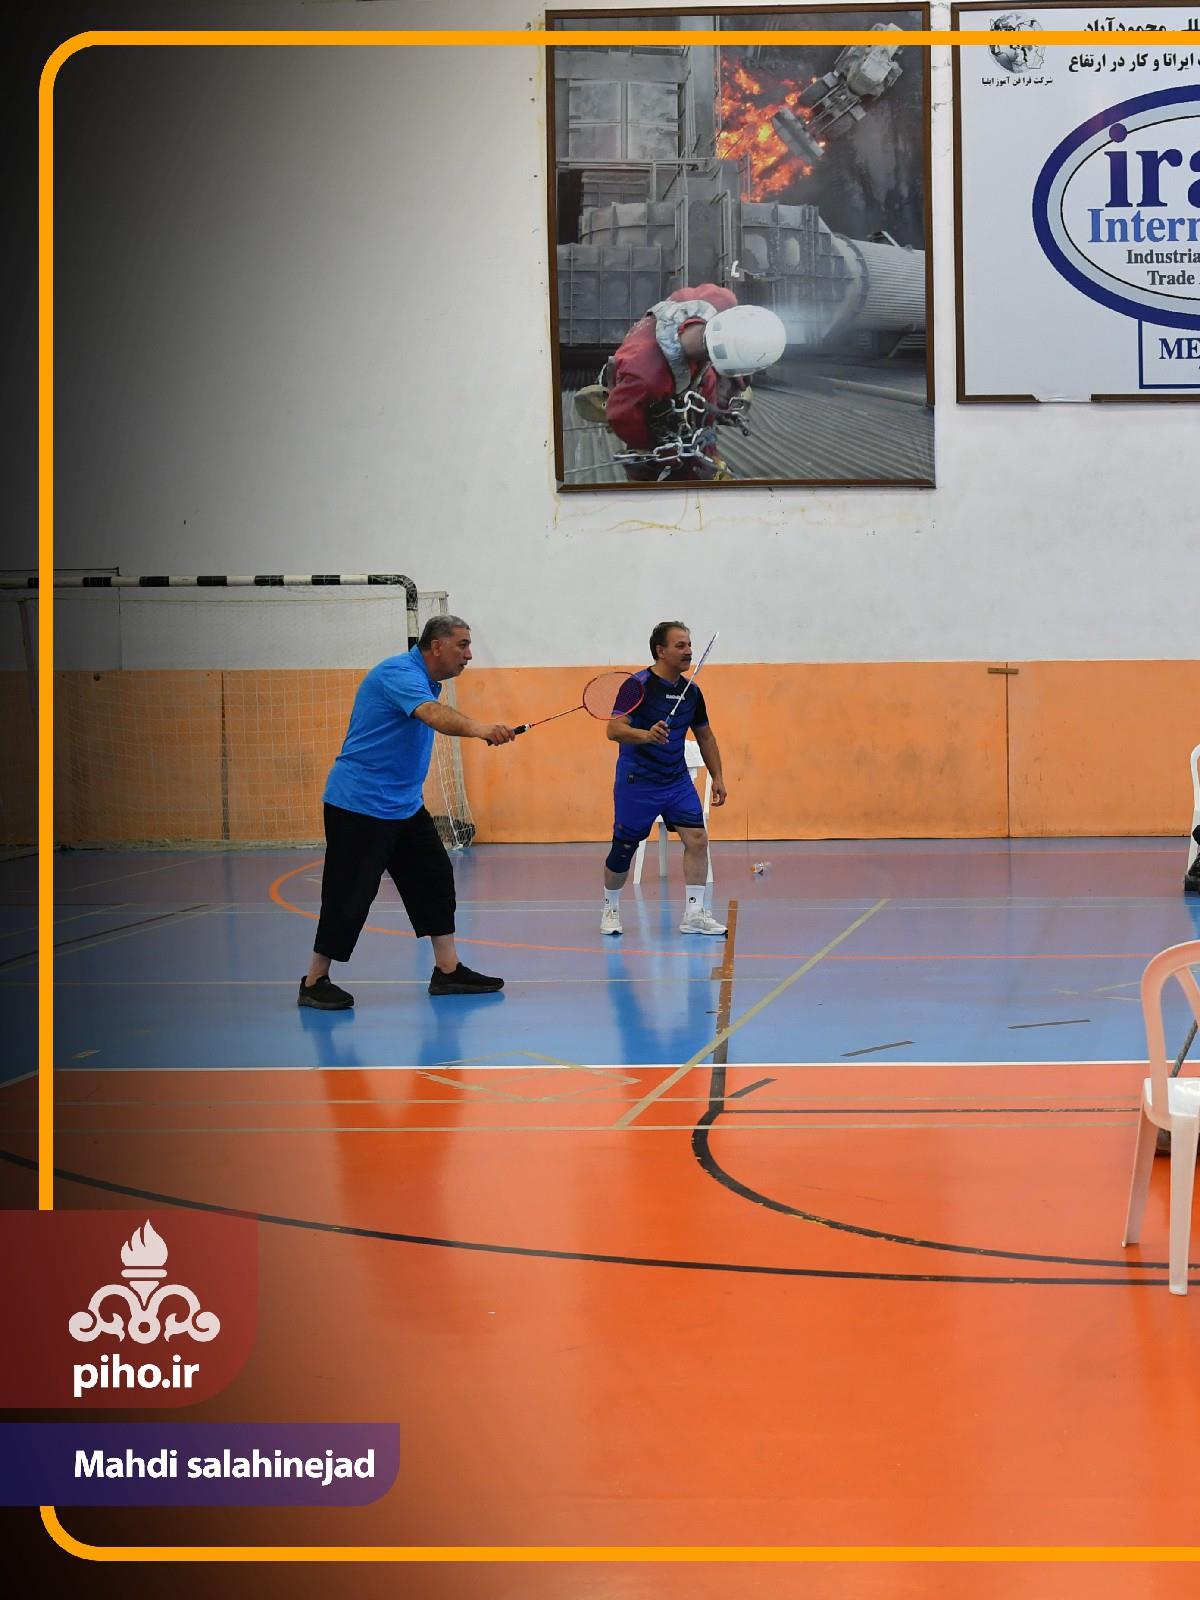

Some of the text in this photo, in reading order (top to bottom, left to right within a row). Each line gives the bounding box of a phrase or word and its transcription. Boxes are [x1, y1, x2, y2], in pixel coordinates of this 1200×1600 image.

[1068, 54, 1106, 73] ارتفاع
[1109, 56, 1125, 72] در
[1128, 53, 1149, 72] کار
[1152, 58, 1160, 72] و
[1163, 53, 1194, 72] ایراتا
[1033, 76, 1053, 86] شرکت
[1147, 269, 1196, 286] Trade
